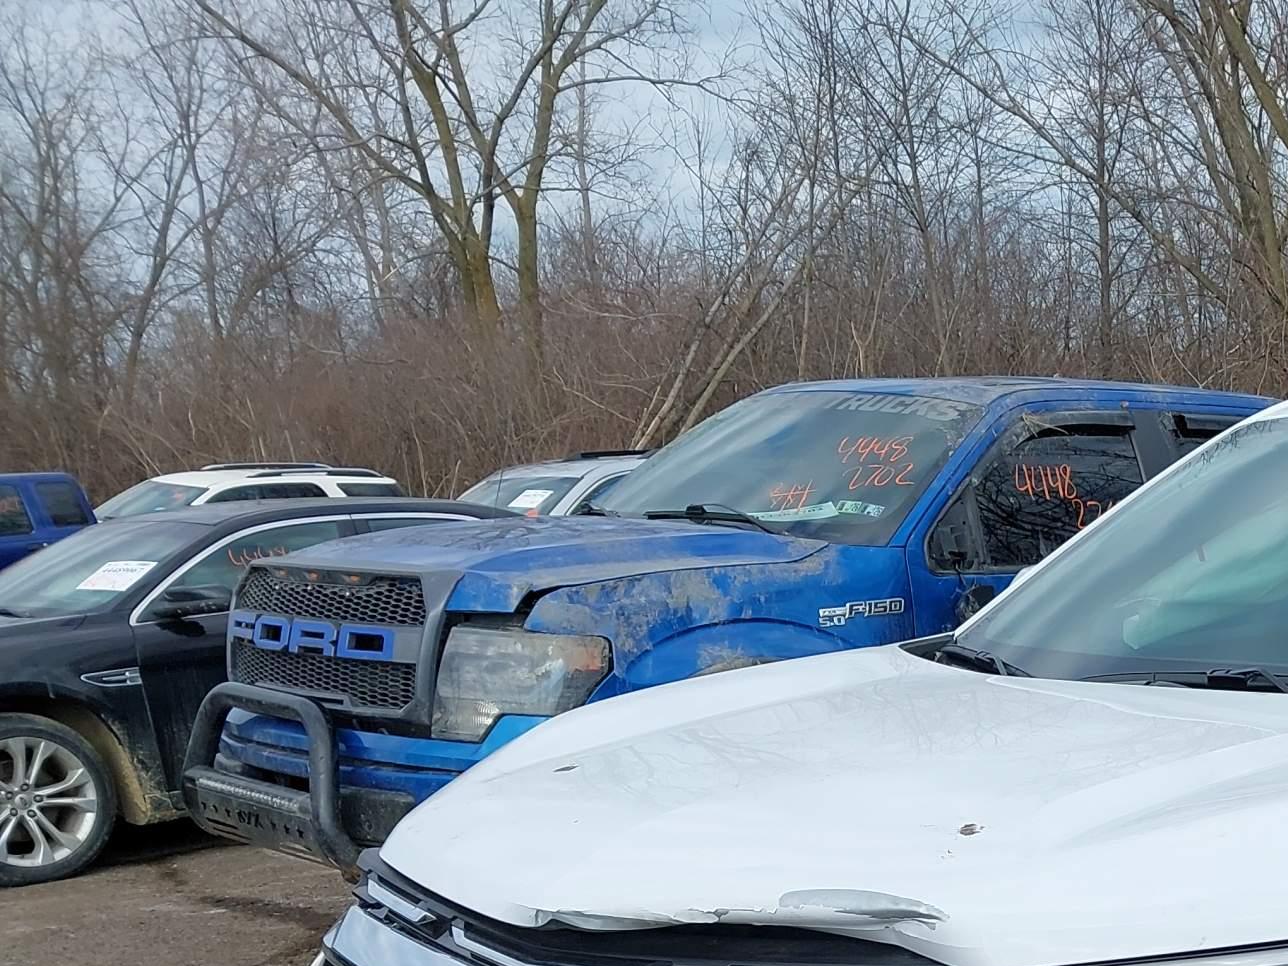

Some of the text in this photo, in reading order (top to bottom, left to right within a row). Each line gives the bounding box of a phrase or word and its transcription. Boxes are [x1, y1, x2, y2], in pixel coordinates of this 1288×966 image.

[824, 392, 968, 422] TRUCKS
[838, 436, 914, 464] 4448
[842, 463, 915, 490] 2702
[1015, 463, 1077, 500] 4448
[819, 616, 846, 627] 5.0
[844, 598, 904, 618] F-150
[228, 610, 394, 661] FORD
